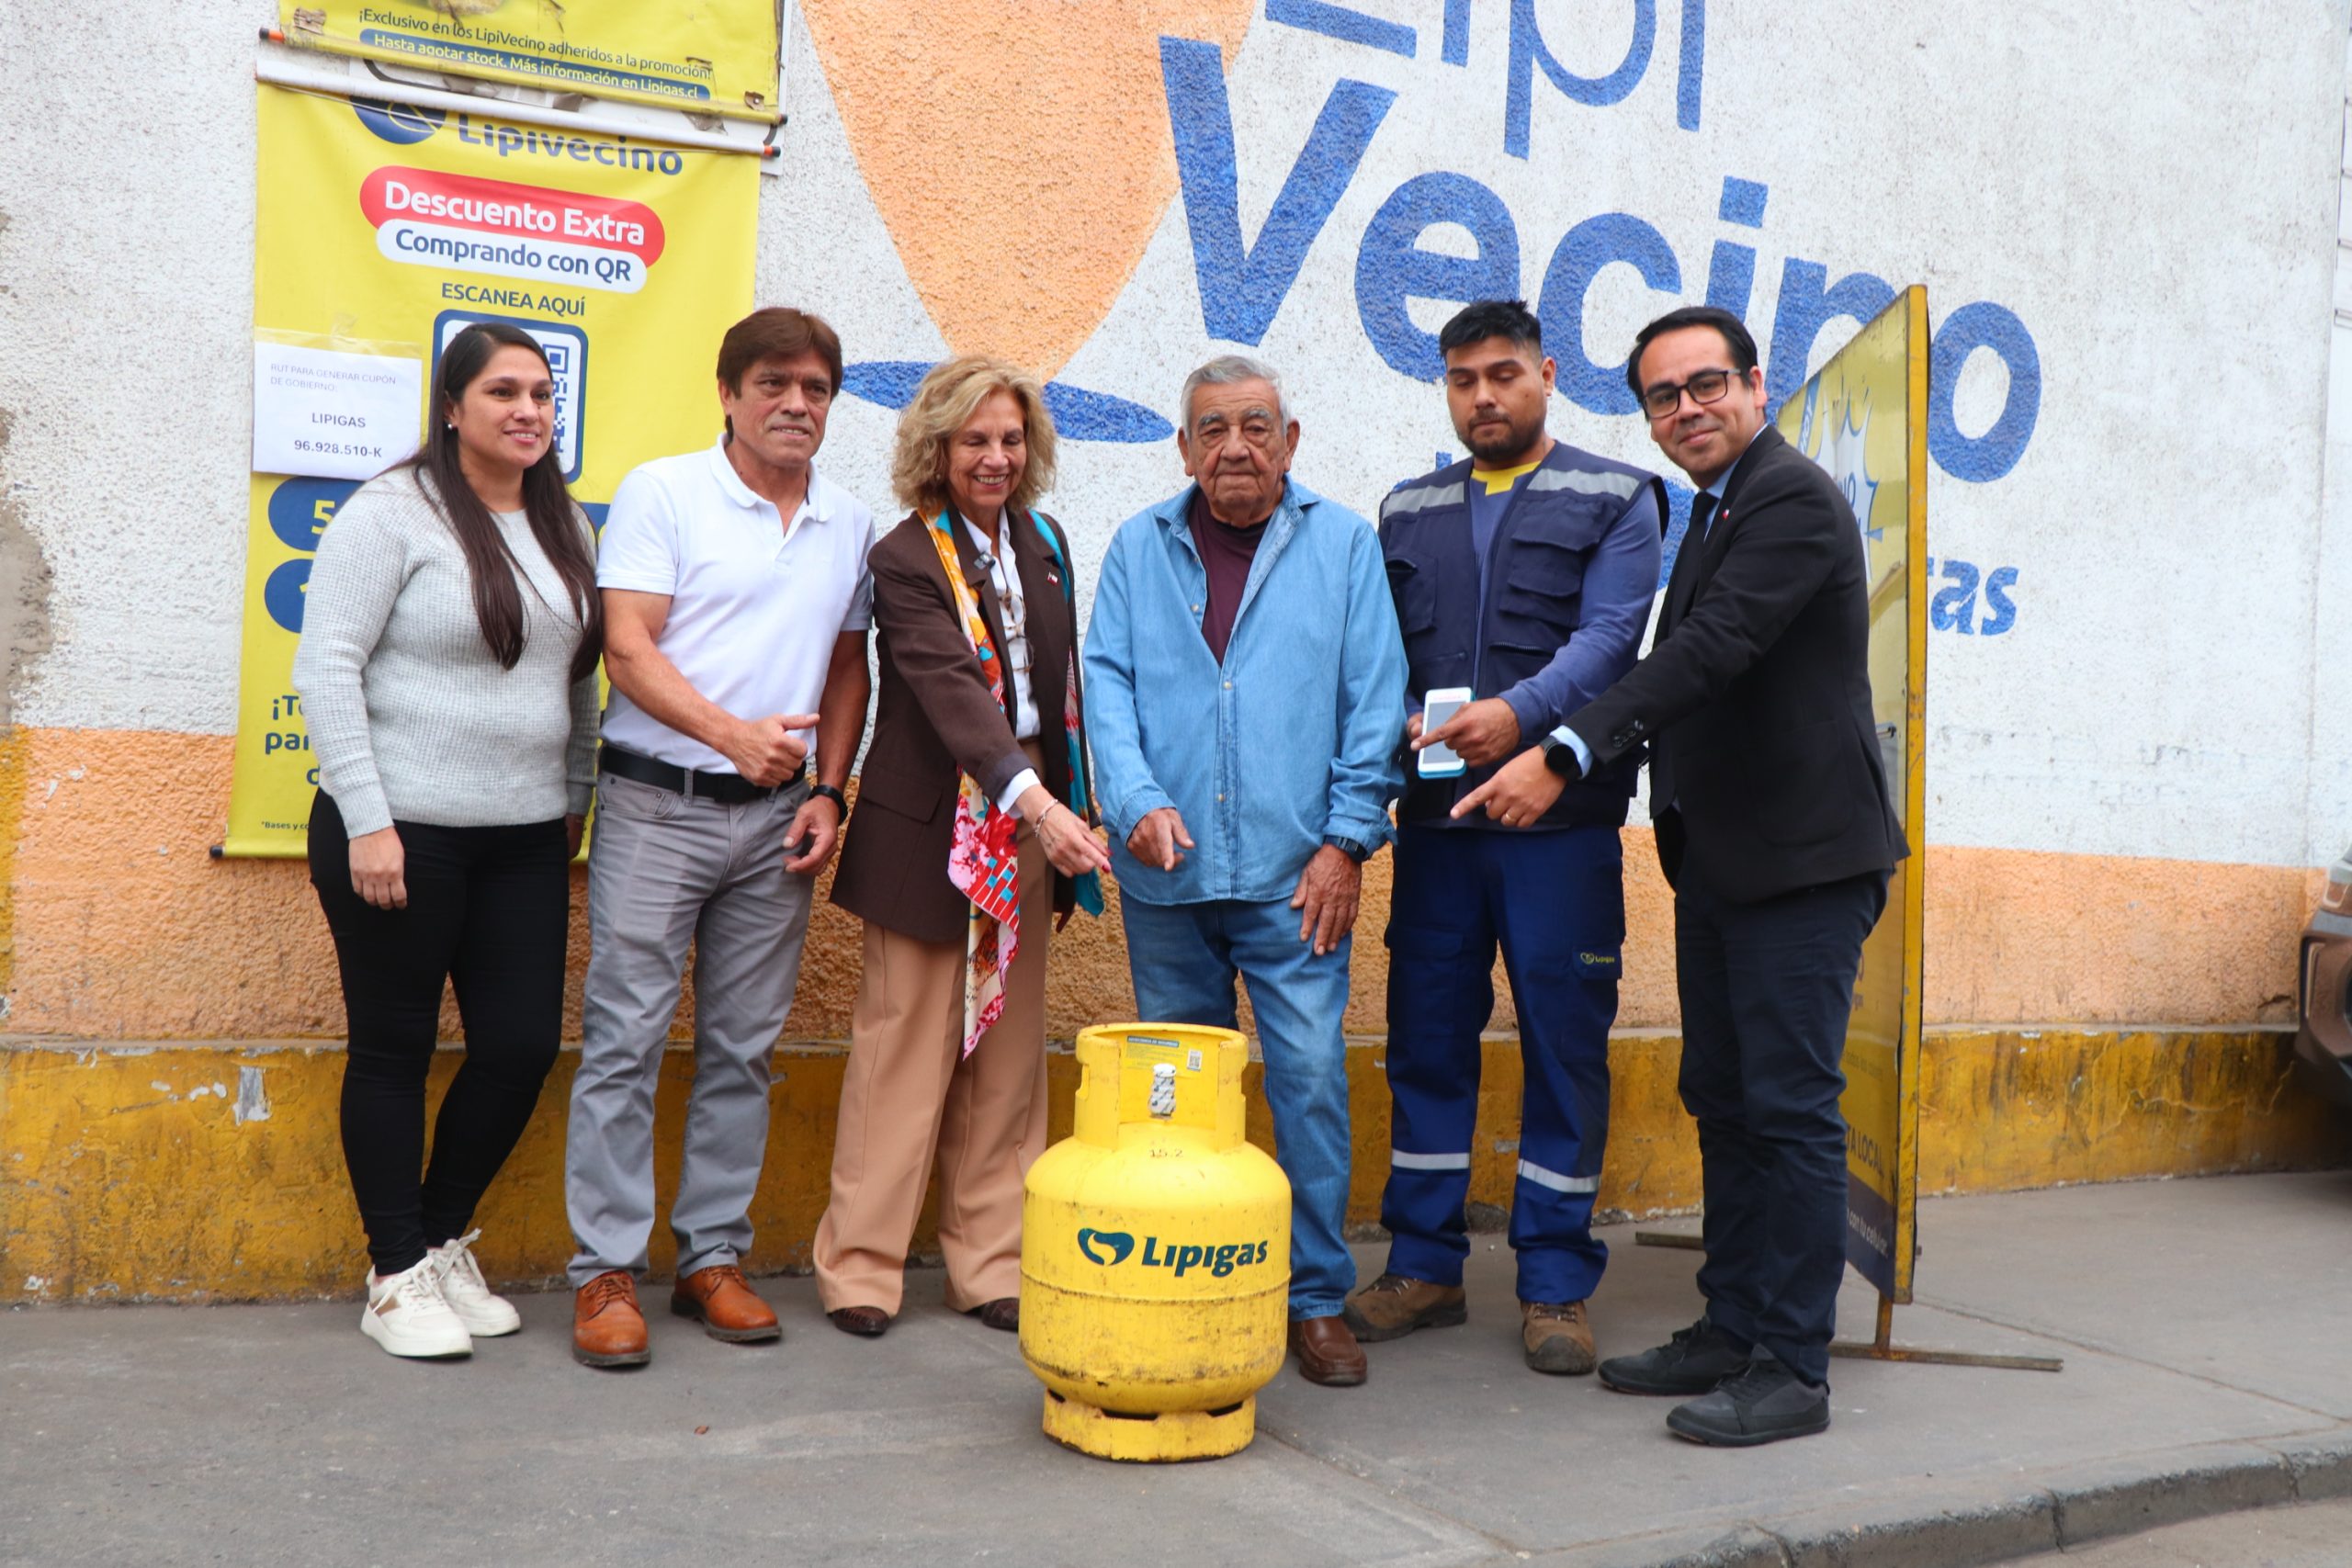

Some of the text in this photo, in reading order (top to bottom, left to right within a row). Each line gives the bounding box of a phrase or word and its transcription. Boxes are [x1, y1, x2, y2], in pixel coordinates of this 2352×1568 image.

[359, 8, 712, 80] ¡Exclusivo en los LipiVecino adheridos a la promoción!
[374, 33, 698, 99] Hasta agotar stock. Más información en Lipigas.cl
[458, 112, 683, 175] Lipivecino
[385, 181, 645, 245] Descuento Extra
[395, 229, 631, 284] Comprando con QR
[1160, 34, 2041, 483] Vecino
[441, 282, 585, 316] ESCANEA AQUÍ
[270, 364, 396, 384] RUT PARA GENERAR CUPÓN
[270, 377, 284, 385] DE
[311, 412, 367, 428] LIPIGAS
[294, 439, 382, 457] 96.928.510-K
[1928, 557, 2019, 635] as
[1141, 1236, 1268, 1278] Lipigas
